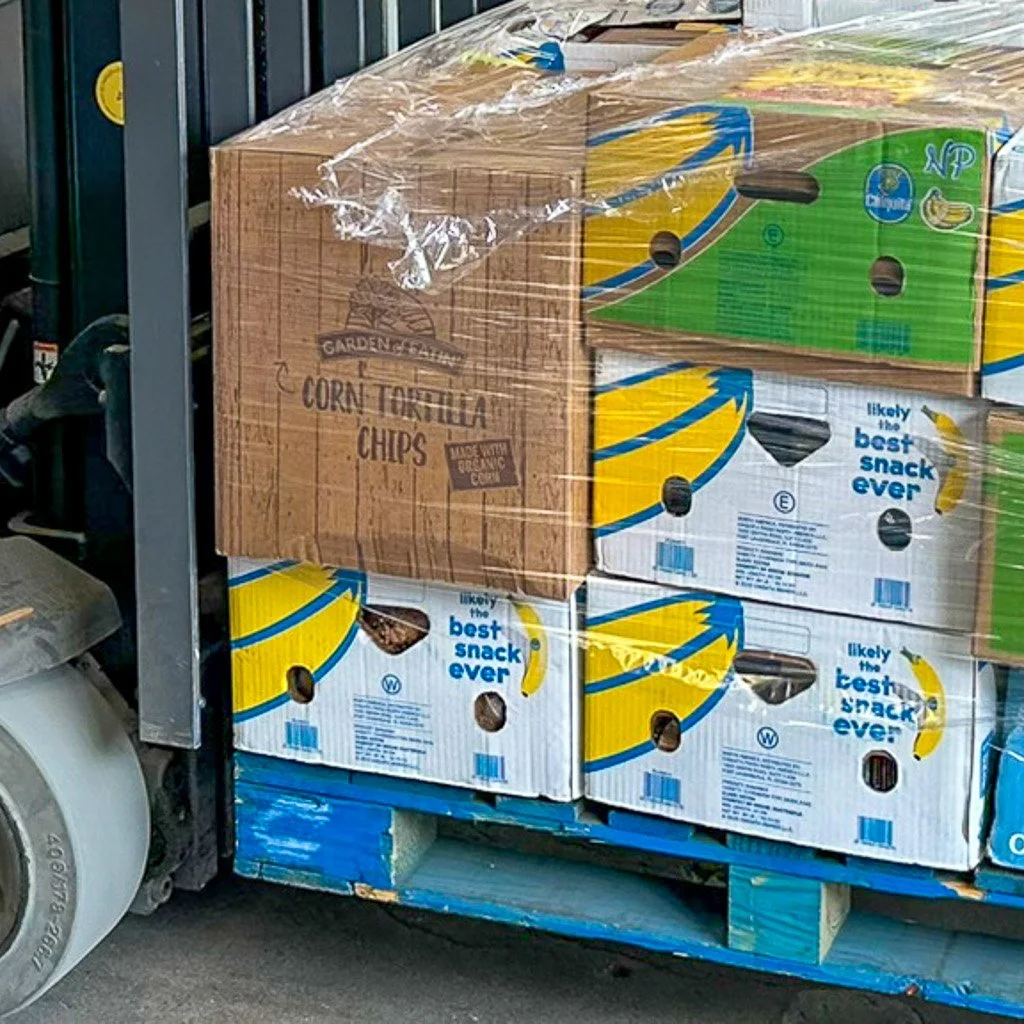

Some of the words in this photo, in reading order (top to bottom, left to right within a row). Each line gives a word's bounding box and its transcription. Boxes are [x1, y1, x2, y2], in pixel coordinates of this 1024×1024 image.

[925, 141, 975, 180] NP
[322, 335, 390, 356] GARDEN
[301, 375, 364, 414] CORN
[377, 382, 487, 431] TORTILLA
[867, 402, 911, 422] likely
[879, 419, 900, 432] the
[358, 425, 428, 467] CHIPS
[854, 427, 913, 454] best
[450, 445, 479, 461] MADE
[457, 457, 506, 474] ORGANIC
[860, 454, 934, 481] snack
[470, 471, 501, 487] CORN
[851, 476, 921, 501] ever
[460, 591, 498, 610] likely
[470, 607, 489, 619] the
[449, 615, 503, 640] best
[454, 642, 522, 664] snack
[848, 642, 892, 663] likely
[449, 661, 512, 683] ever
[859, 660, 880, 673] the
[835, 667, 894, 696] best
[841, 696, 918, 725] snack
[833, 718, 902, 743] ever
